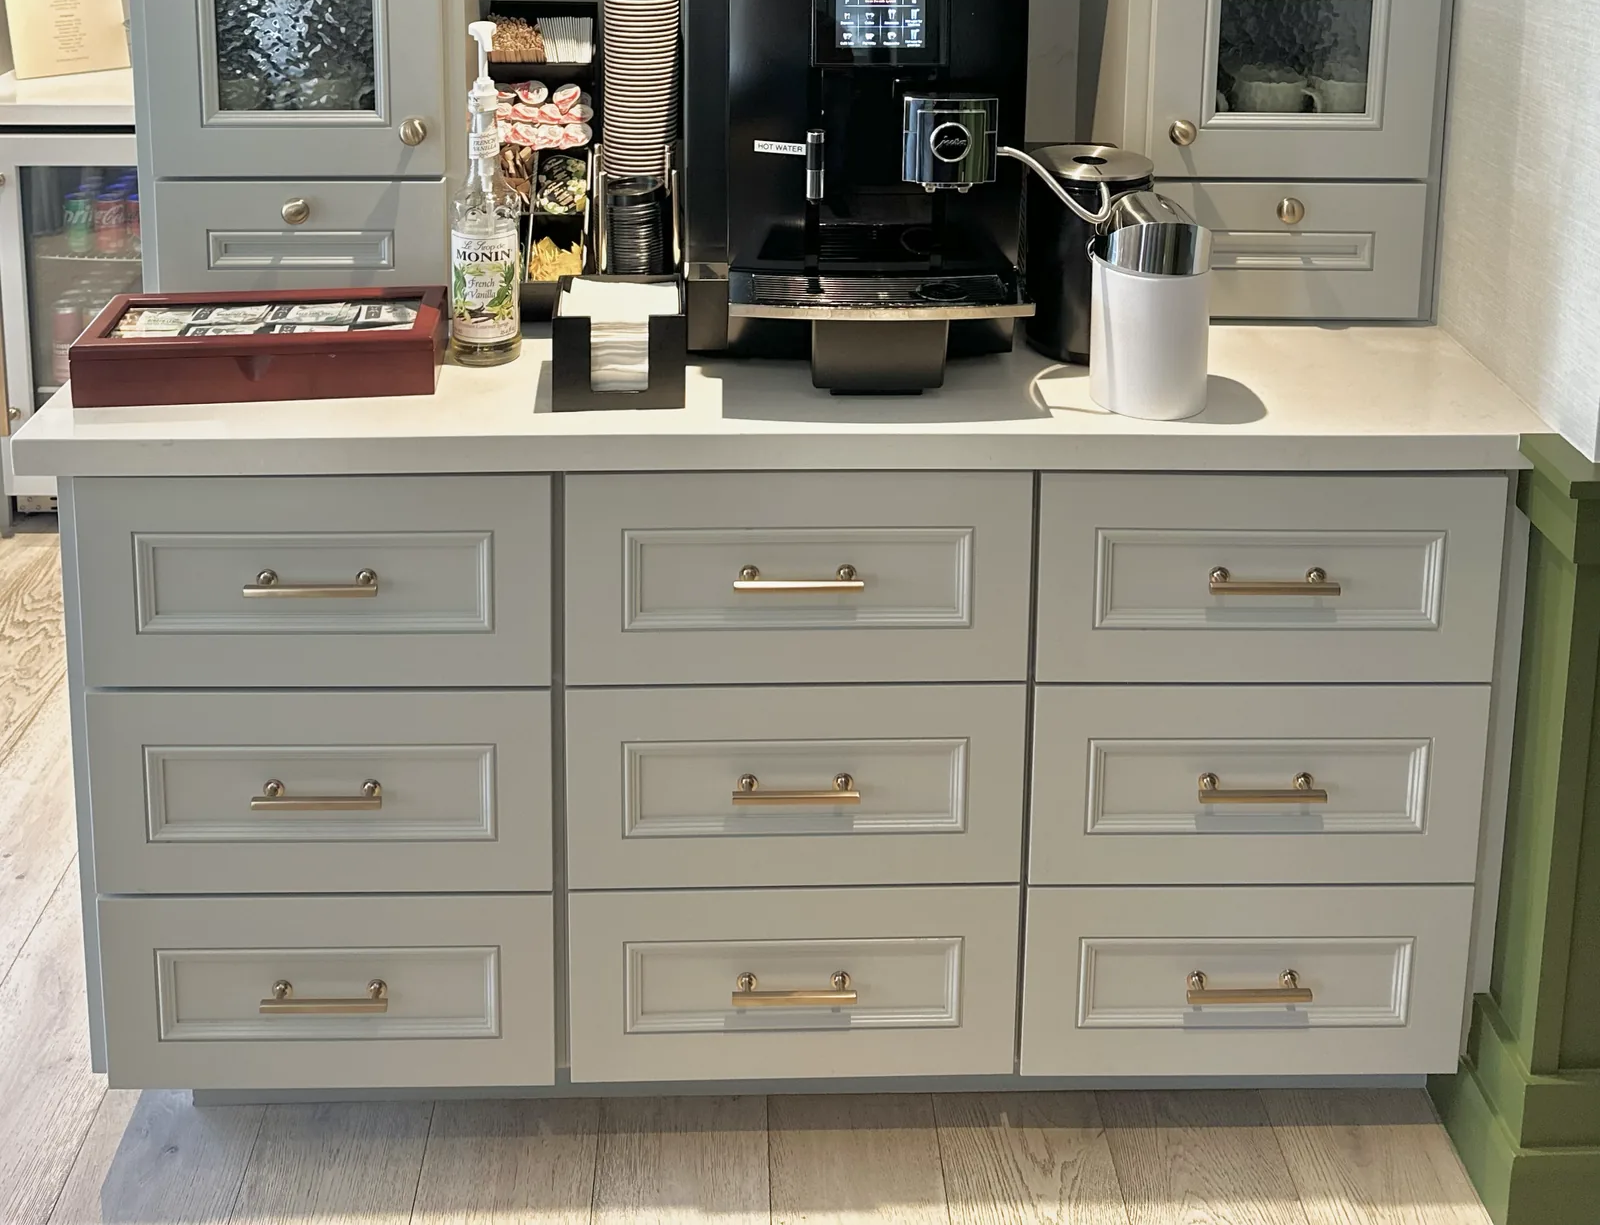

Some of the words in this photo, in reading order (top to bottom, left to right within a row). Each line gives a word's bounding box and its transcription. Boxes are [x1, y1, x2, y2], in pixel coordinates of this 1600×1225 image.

[757, 143, 774, 152] HOT
[775, 144, 803, 154] WATER
[456, 248, 511, 263] MONIN
[467, 278, 495, 289] French
[470, 288, 496, 300] Vanilla
